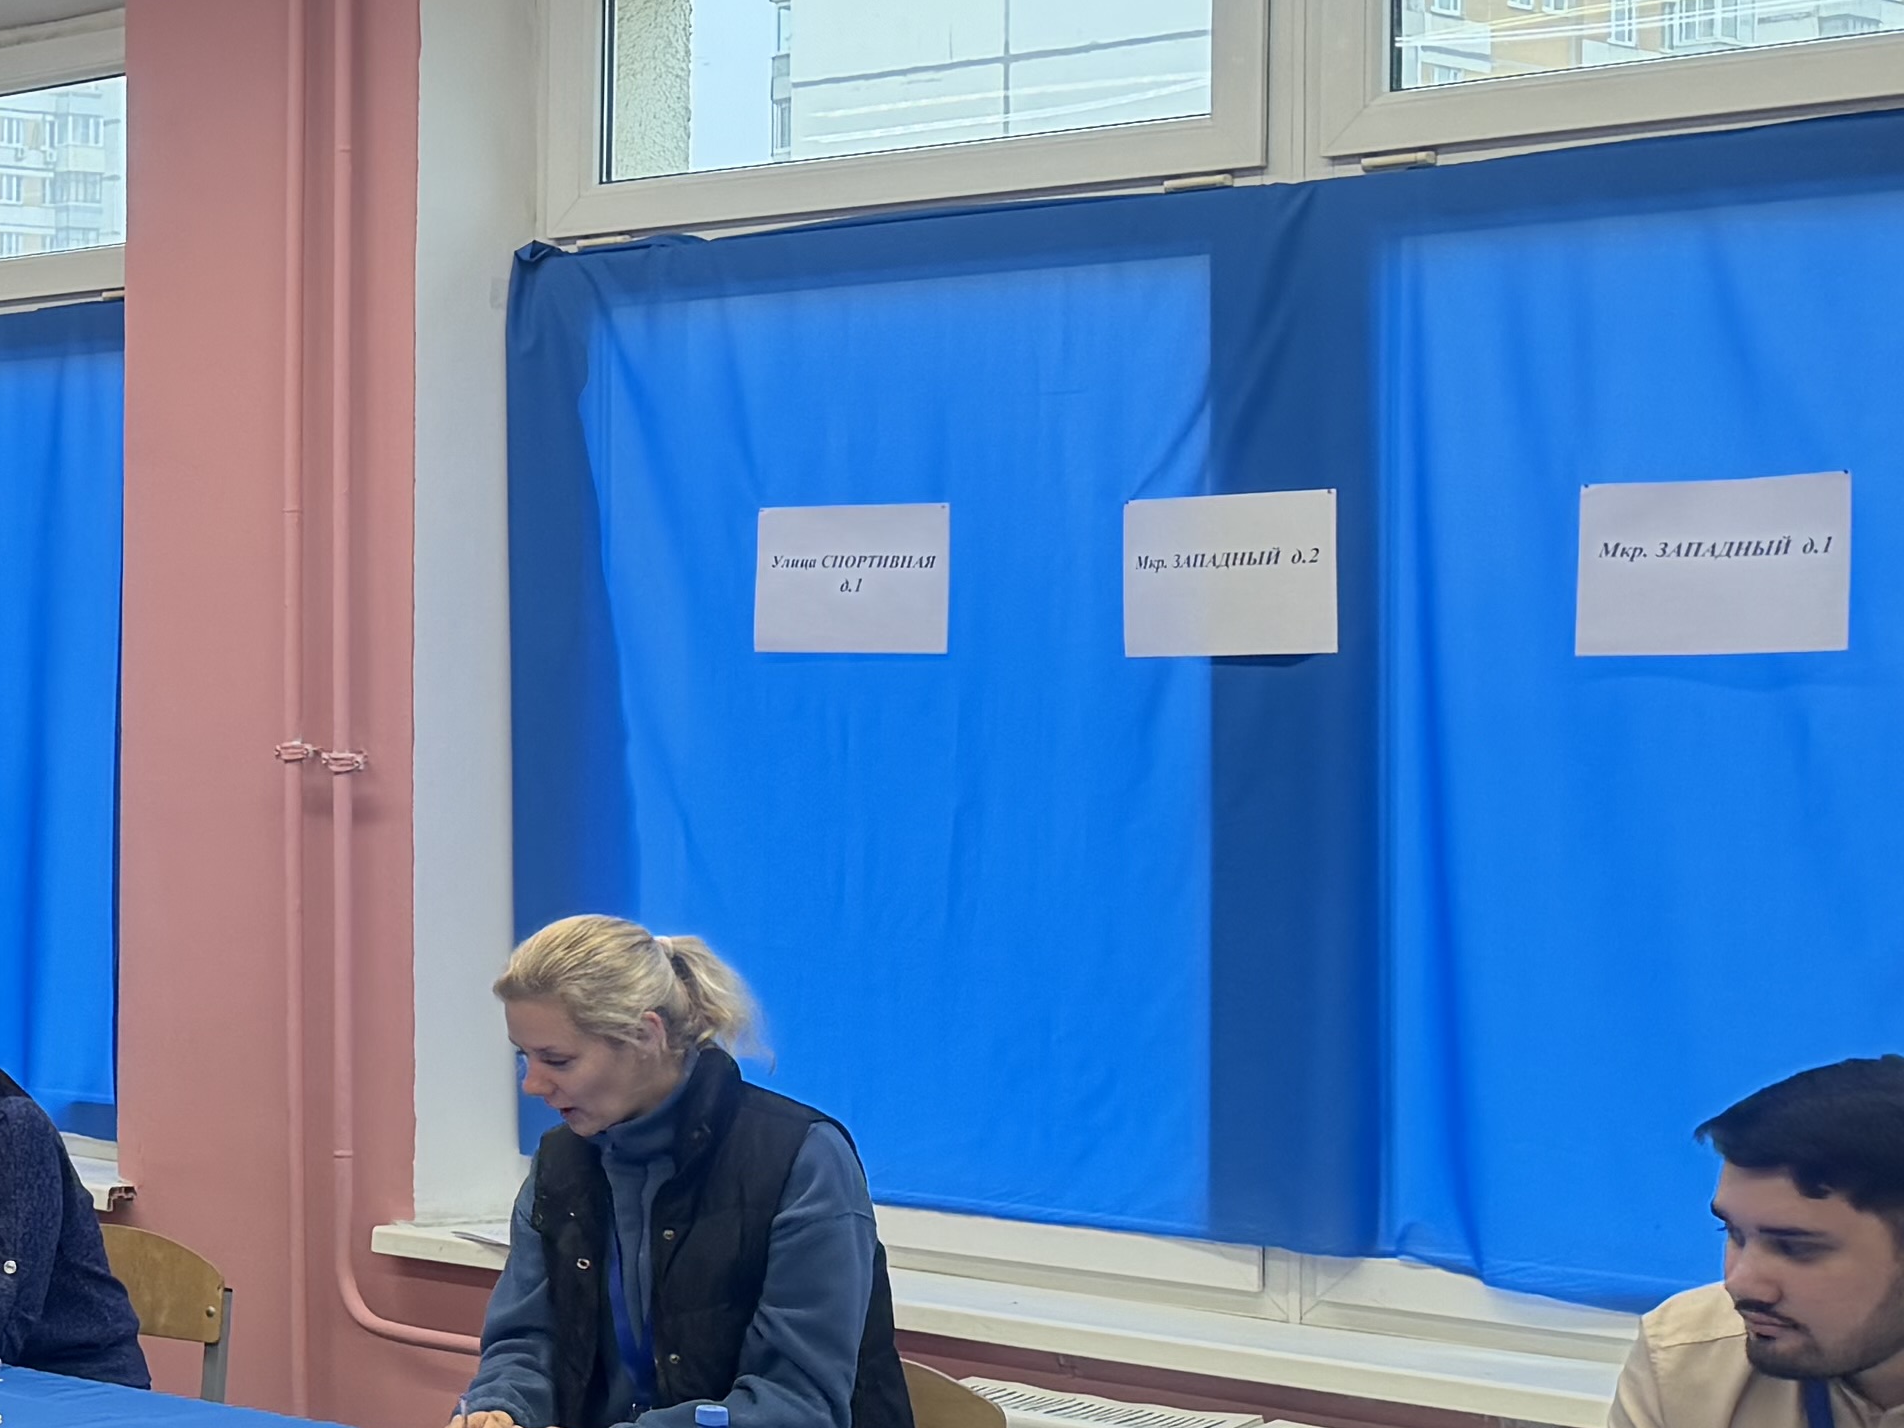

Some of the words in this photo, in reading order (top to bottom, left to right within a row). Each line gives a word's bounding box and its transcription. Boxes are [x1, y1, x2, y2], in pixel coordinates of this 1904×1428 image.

[1599, 542, 1648, 563] Мкр.
[1655, 535, 1792, 560] ЗАПАДНЫЙ
[1802, 536, 1833, 554] д.1
[771, 555, 816, 570] Улица
[821, 554, 936, 569] СПОРТИВНАЯ
[1136, 555, 1167, 573] Мкр.
[1172, 547, 1281, 569] ЗАПАДНЫЙ
[1291, 547, 1320, 564] д.2
[840, 578, 862, 592] д.1
